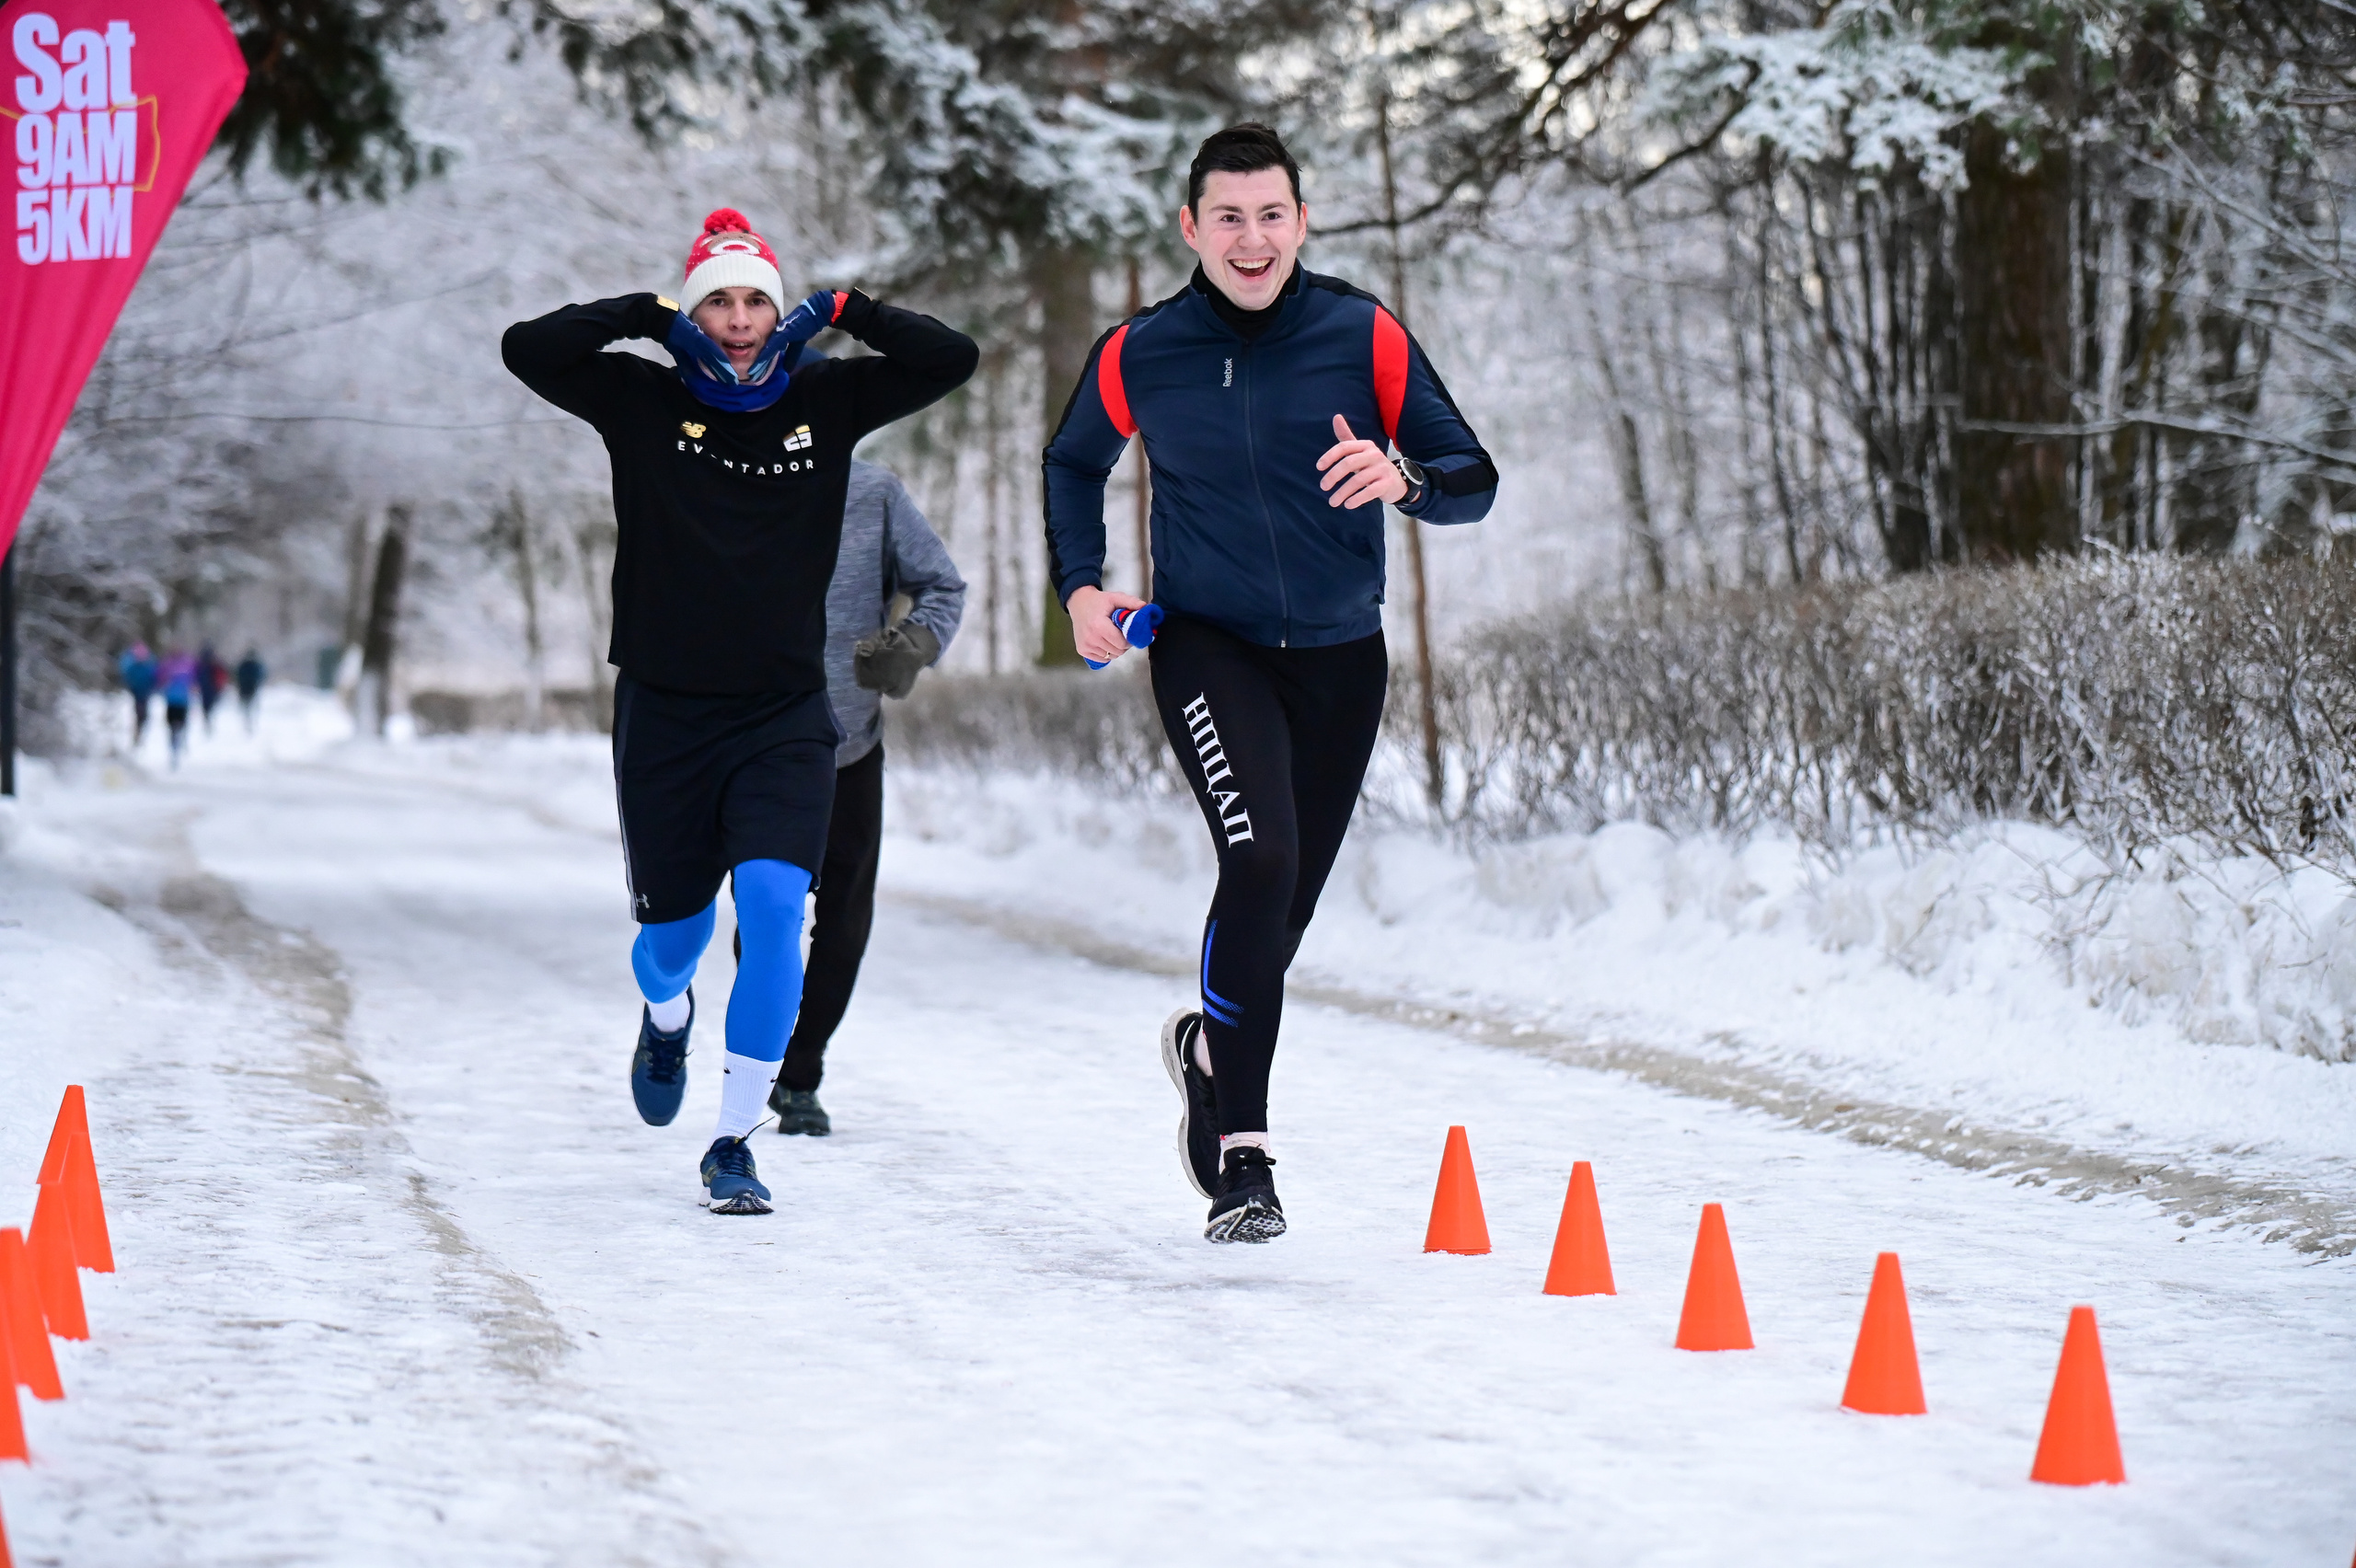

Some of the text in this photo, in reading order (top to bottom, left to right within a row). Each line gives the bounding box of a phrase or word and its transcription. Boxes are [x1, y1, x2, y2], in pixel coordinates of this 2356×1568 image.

[13, 12, 137, 113] Sat
[16, 110, 137, 189] 9AM
[17, 185, 133, 265] 5KM
[1222, 358, 1233, 387] Reebok
[676, 440, 814, 476] EVNTADOR
